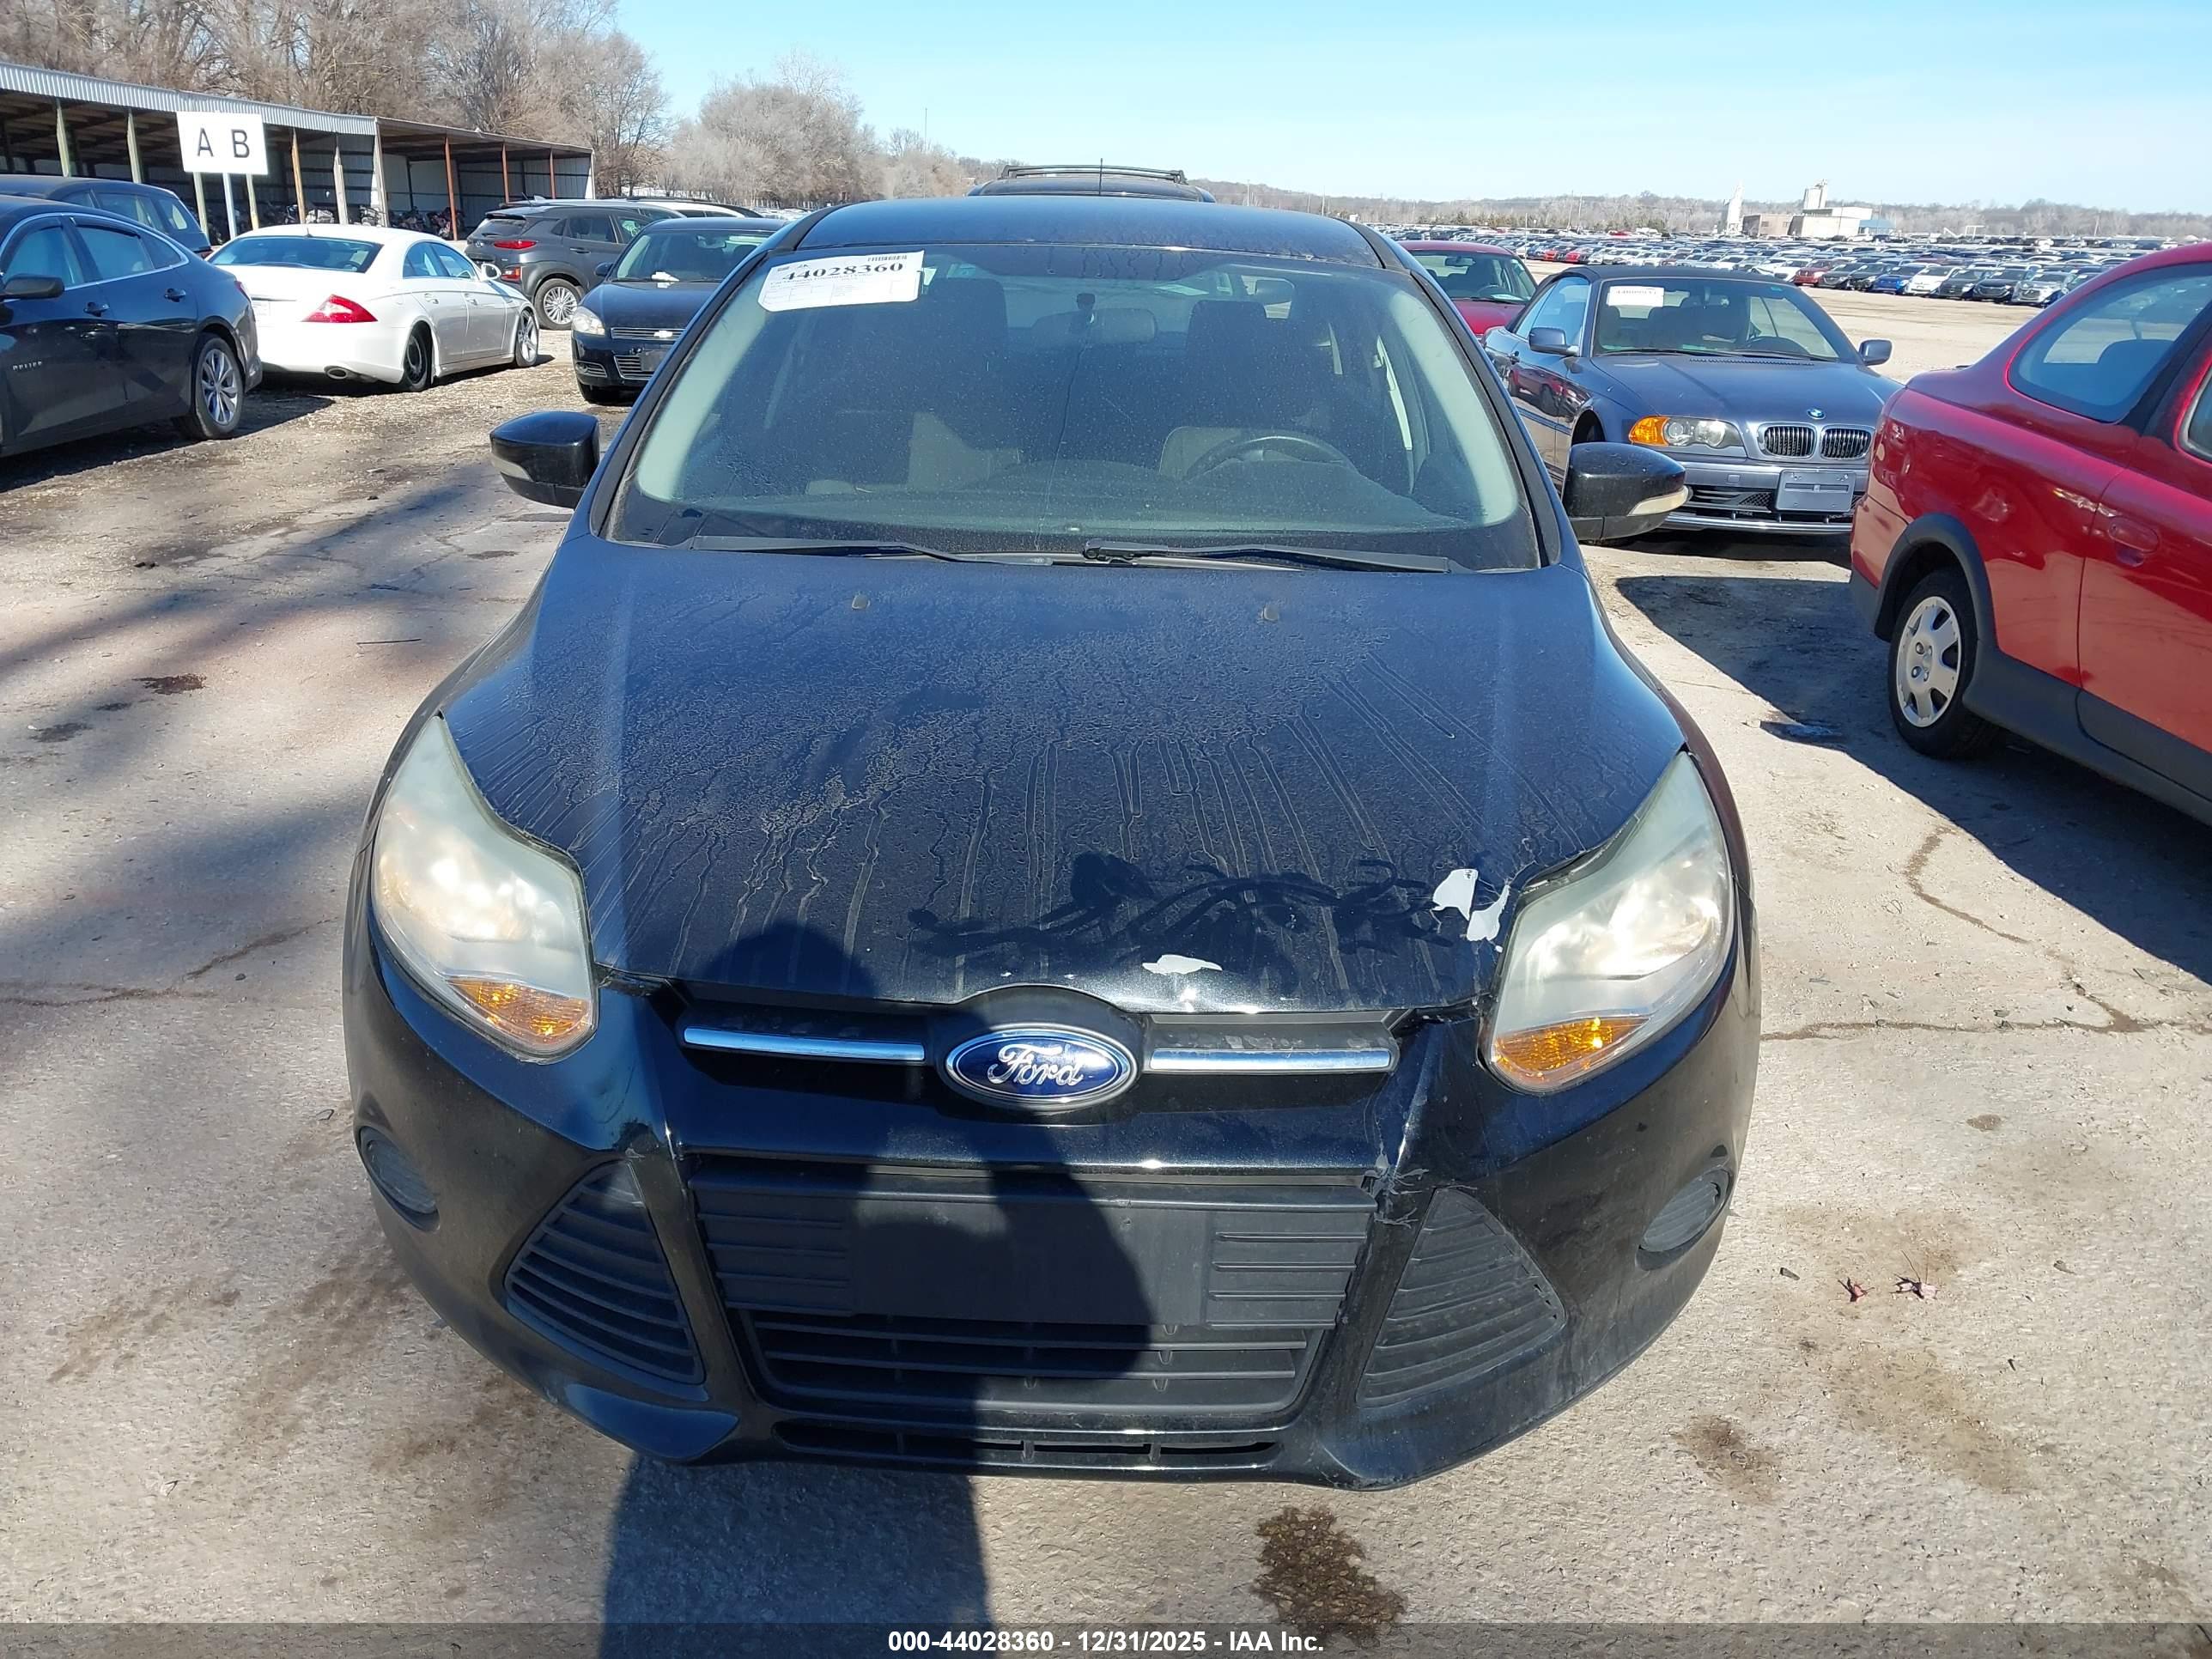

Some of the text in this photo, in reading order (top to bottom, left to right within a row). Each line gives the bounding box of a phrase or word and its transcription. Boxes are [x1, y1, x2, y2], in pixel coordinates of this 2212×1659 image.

[197, 127, 250, 158] A B
[782, 262, 903, 281] 44028360
[987, 1043, 1084, 1086] Ford
